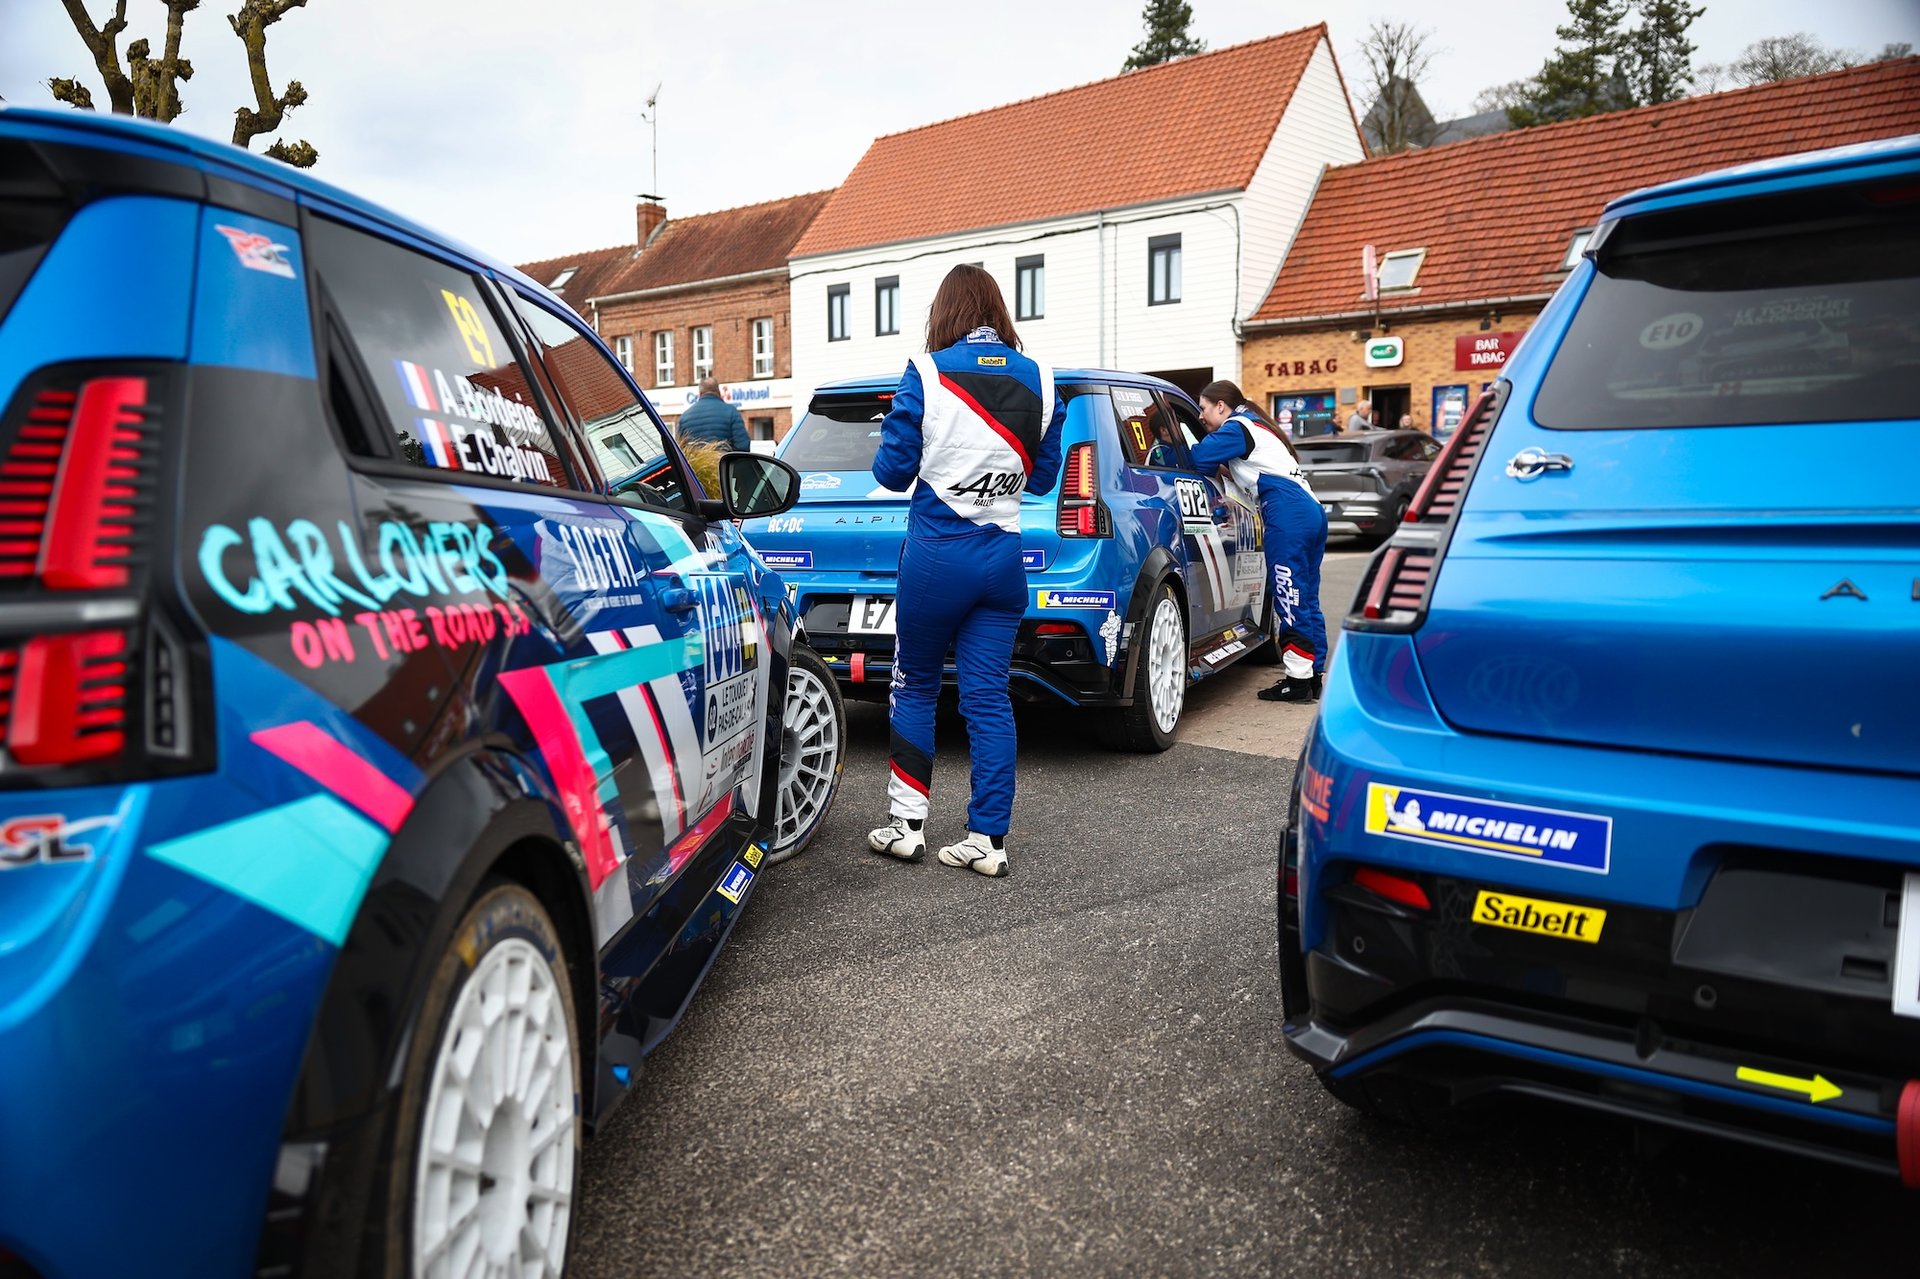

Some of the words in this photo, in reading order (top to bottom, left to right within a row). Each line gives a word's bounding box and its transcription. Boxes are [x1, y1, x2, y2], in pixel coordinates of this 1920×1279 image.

[1475, 338, 1499, 351] BAR
[1649, 320, 1694, 343] E10
[1470, 351, 1505, 364] TABAC
[450, 424, 551, 481] E.Chalvin
[198, 516, 382, 616] CAR
[338, 520, 509, 600] LOVERS
[765, 555, 804, 564] MICHELIN
[1062, 596, 1109, 604] MICHELIN
[290, 617, 355, 669] ON
[354, 608, 429, 661] THE
[426, 602, 497, 650] ROAD
[1427, 810, 1578, 850] MICHELIN
[1481, 896, 1590, 938] Sabelt
